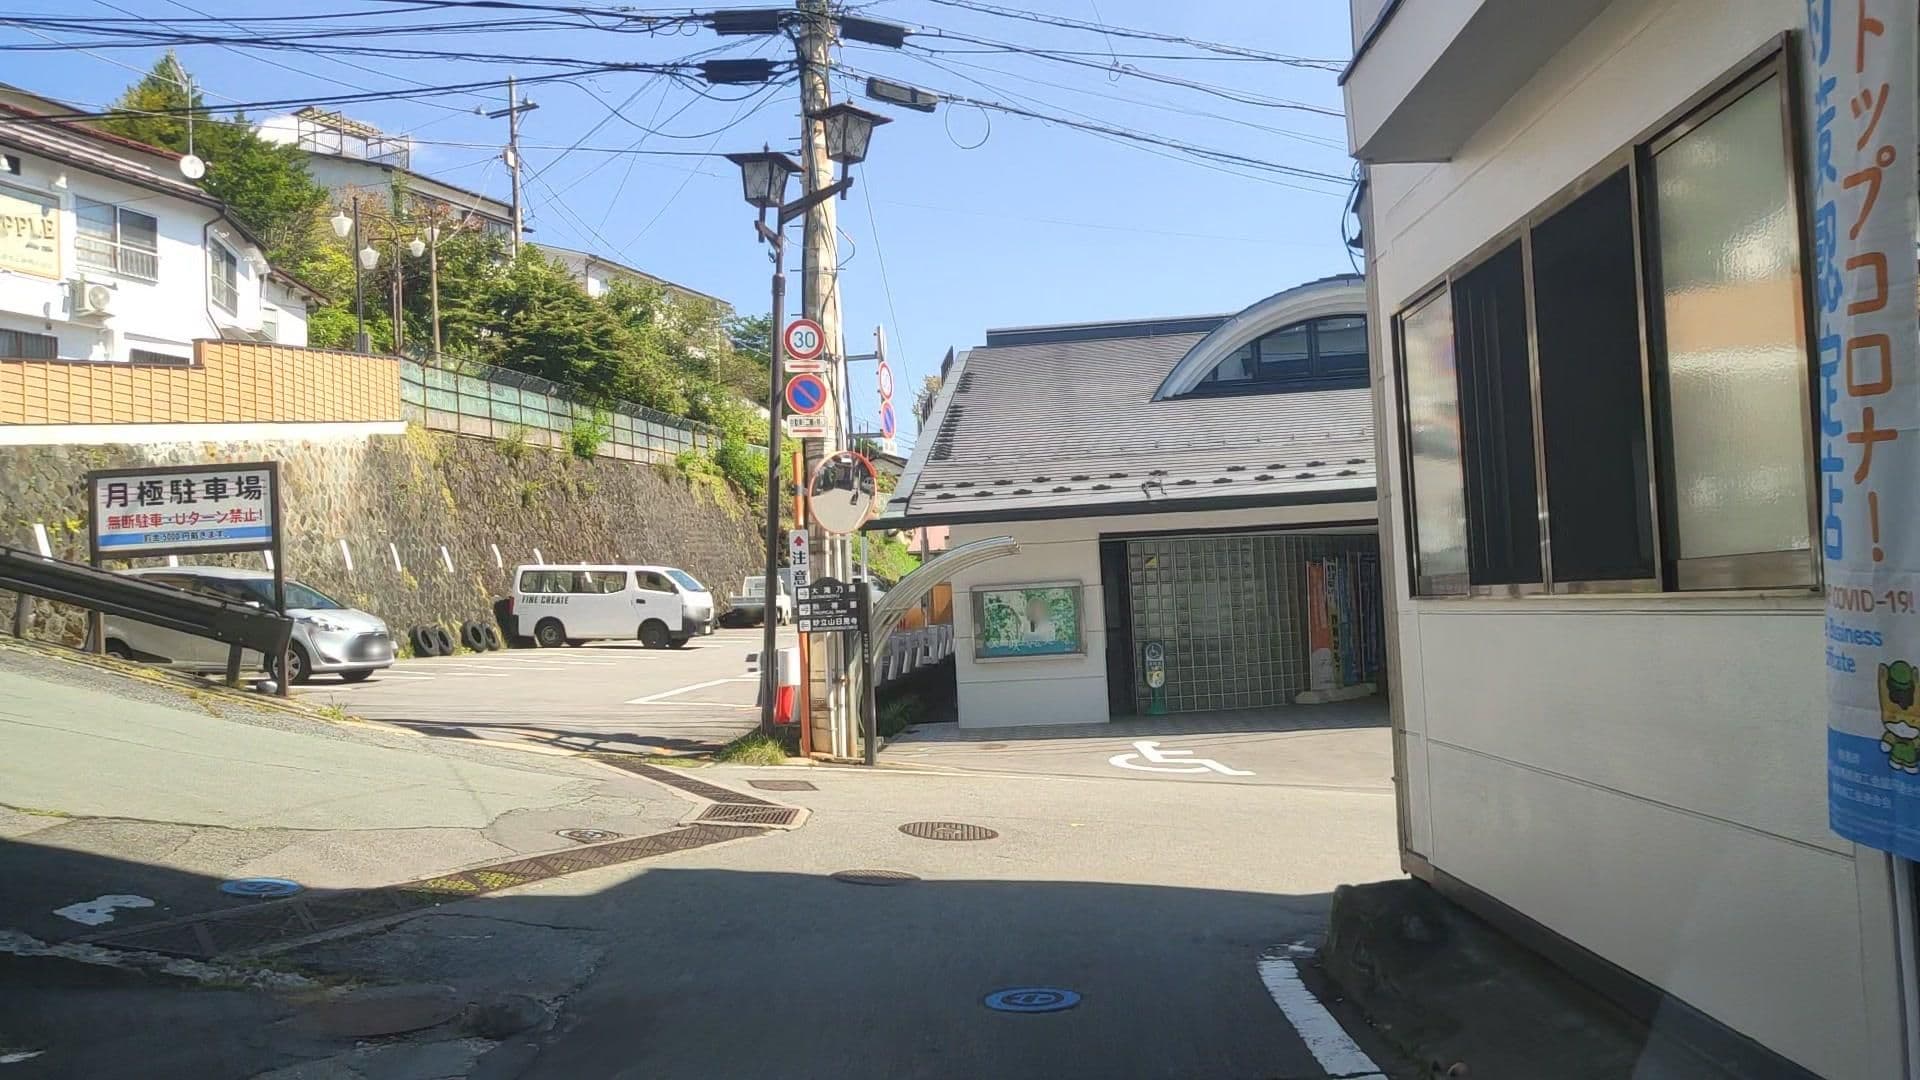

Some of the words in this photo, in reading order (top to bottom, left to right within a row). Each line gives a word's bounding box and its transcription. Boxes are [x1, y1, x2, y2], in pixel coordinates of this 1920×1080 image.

[0, 215, 55, 240] PPLE
[793, 331, 816, 349] 30
[105, 474, 263, 509] 月極駐車場
[792, 551, 808, 586] 注意
[521, 595, 538, 604] FINE
[540, 595, 569, 604] CREATE
